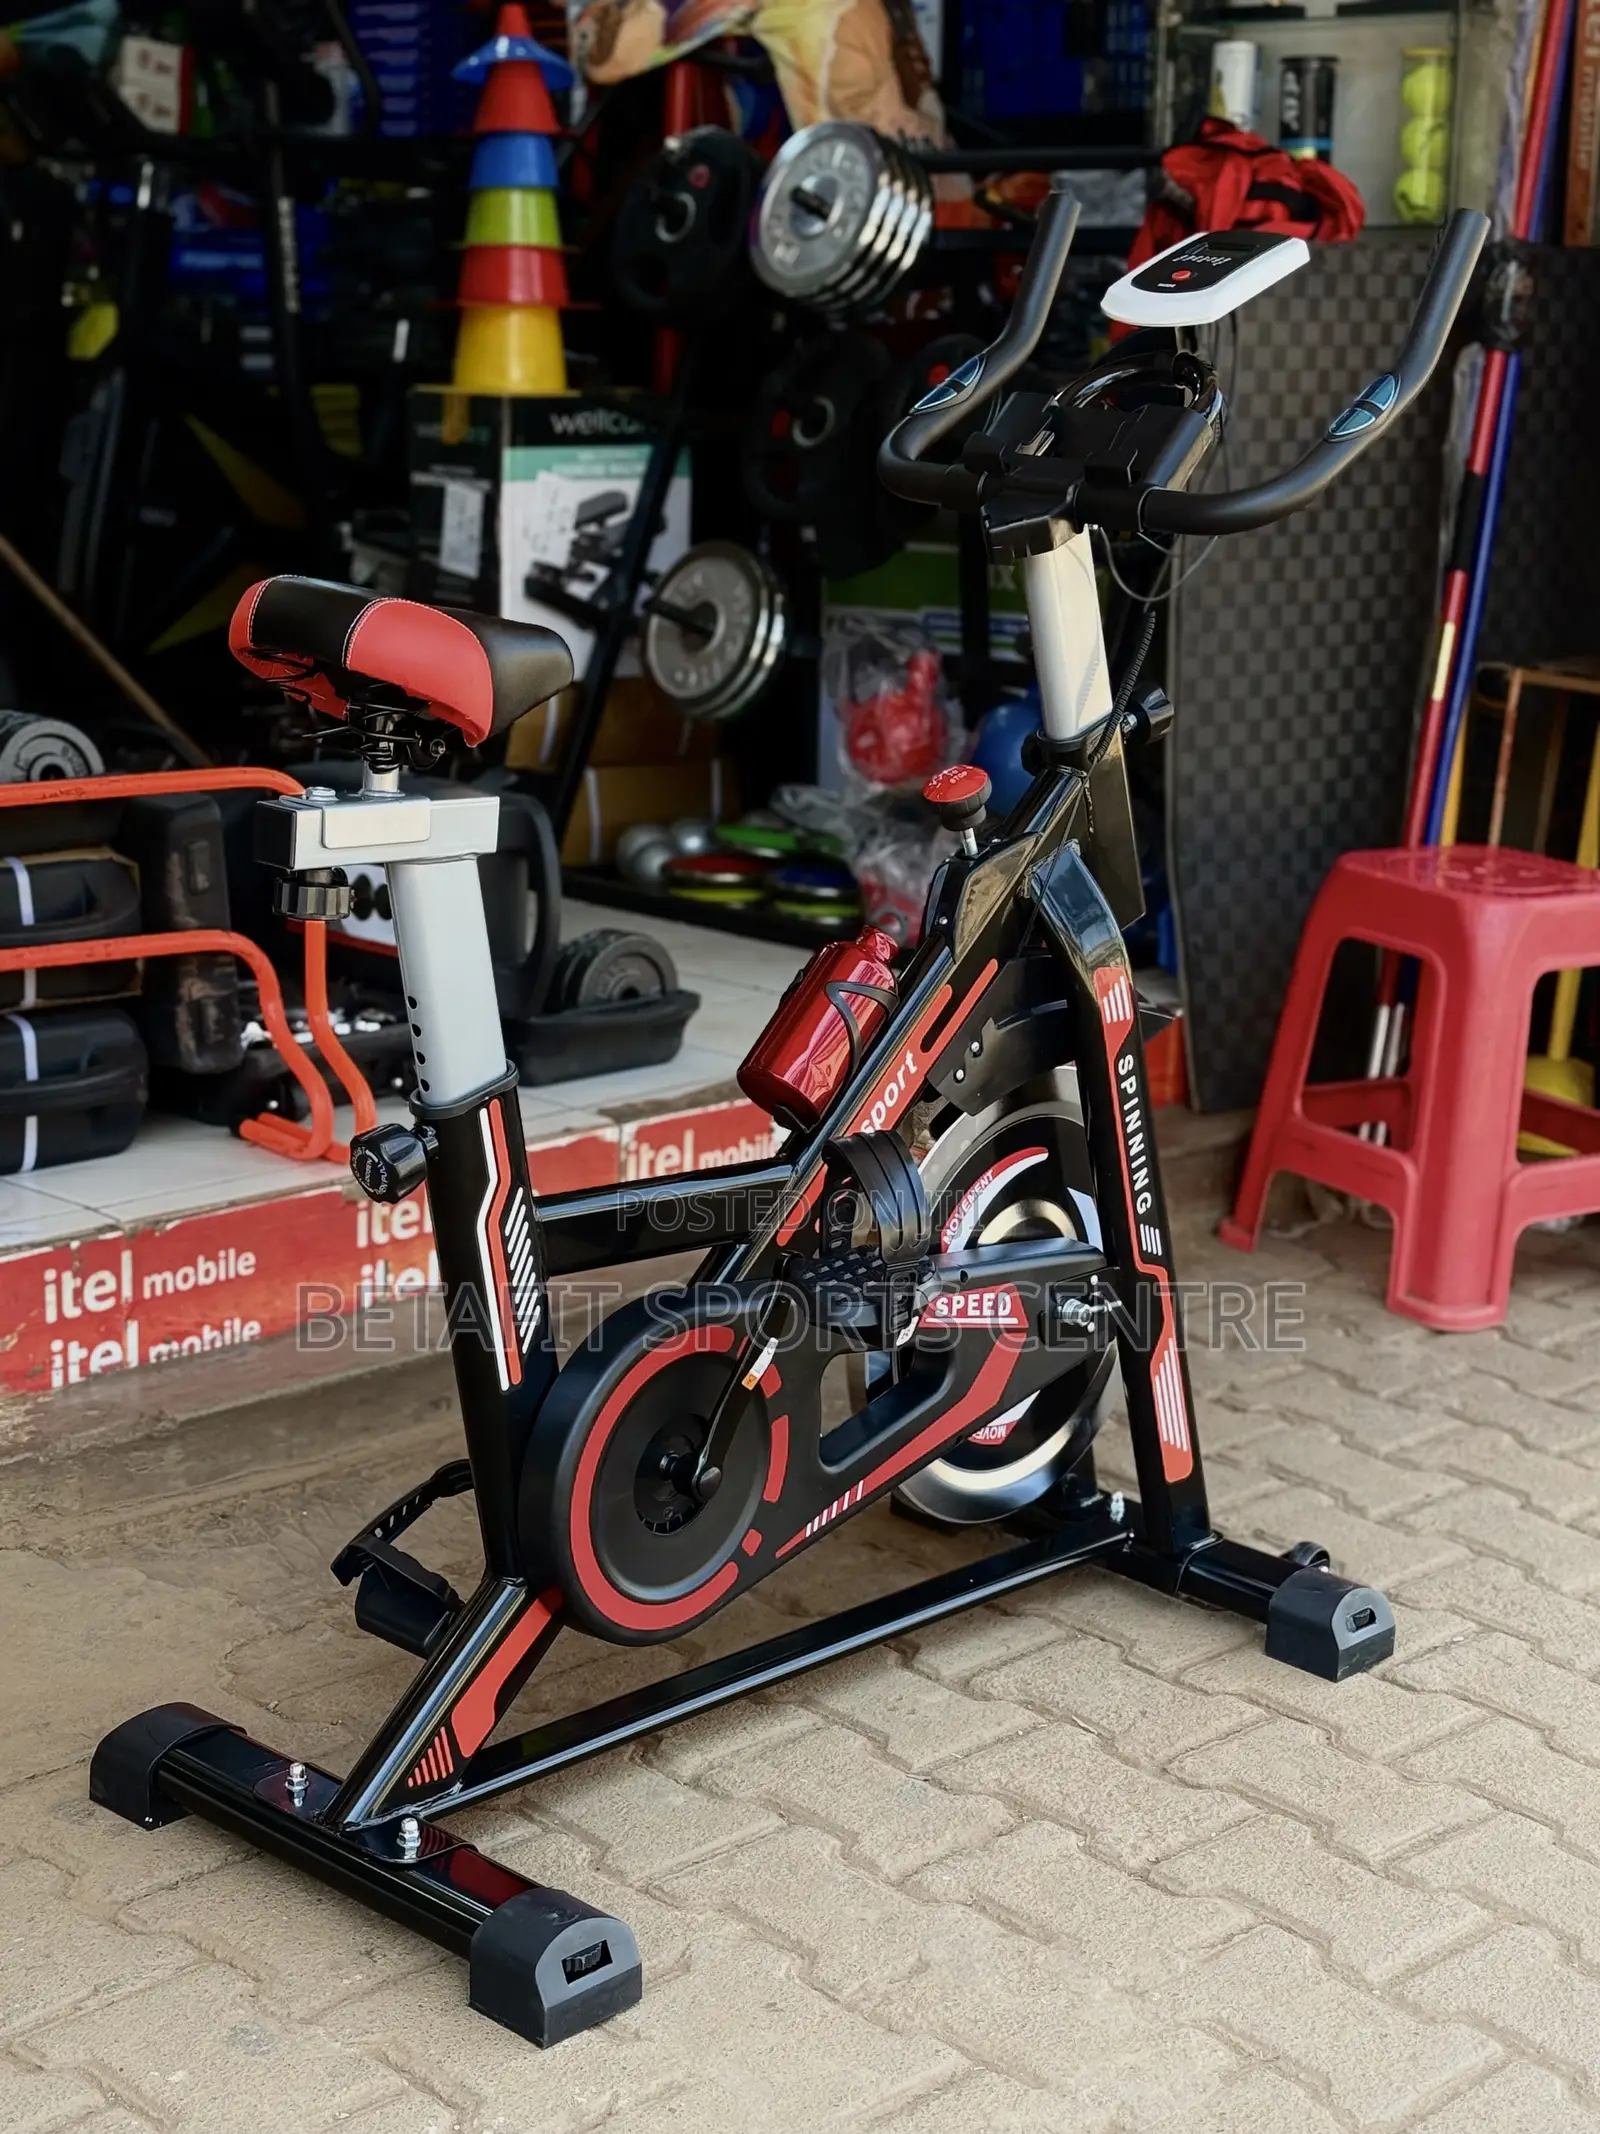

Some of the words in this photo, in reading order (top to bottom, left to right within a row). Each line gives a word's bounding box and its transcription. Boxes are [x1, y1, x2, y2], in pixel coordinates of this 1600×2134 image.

[626, 1129, 694, 1182] itel
[1117, 1053, 1152, 1215] SPINNING
[943, 1168, 995, 1245] MOVEMENT
[43, 1249, 133, 1324] itel
[142, 1246, 257, 1300] mobile
[934, 1291, 1012, 1318] SPEED
[50, 1319, 140, 1389] itel
[147, 1316, 262, 1365] mobile
